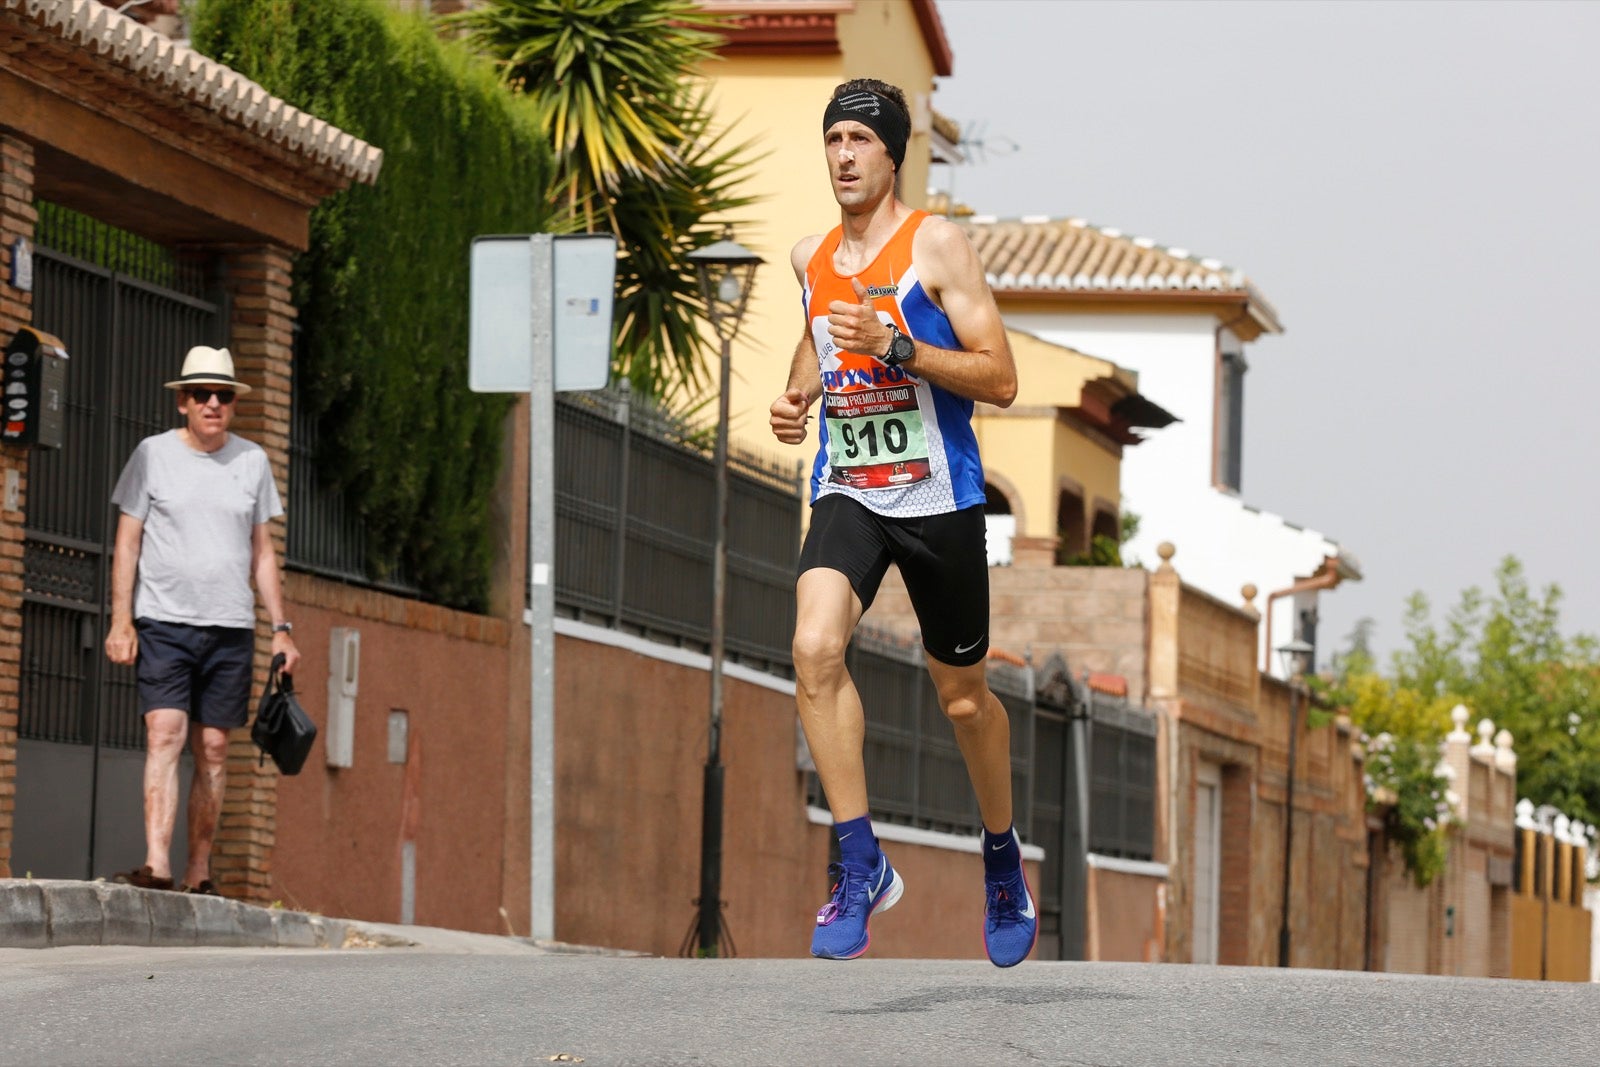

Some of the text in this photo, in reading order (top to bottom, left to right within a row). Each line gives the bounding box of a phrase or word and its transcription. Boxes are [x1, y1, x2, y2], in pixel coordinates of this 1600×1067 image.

[818, 342, 833, 365] CLUB
[849, 392, 876, 406] PREMIO
[876, 391, 886, 402] DE
[885, 388, 909, 402] FONDO
[863, 404, 894, 414] CRUZCAMPO
[841, 418, 908, 459] 910
